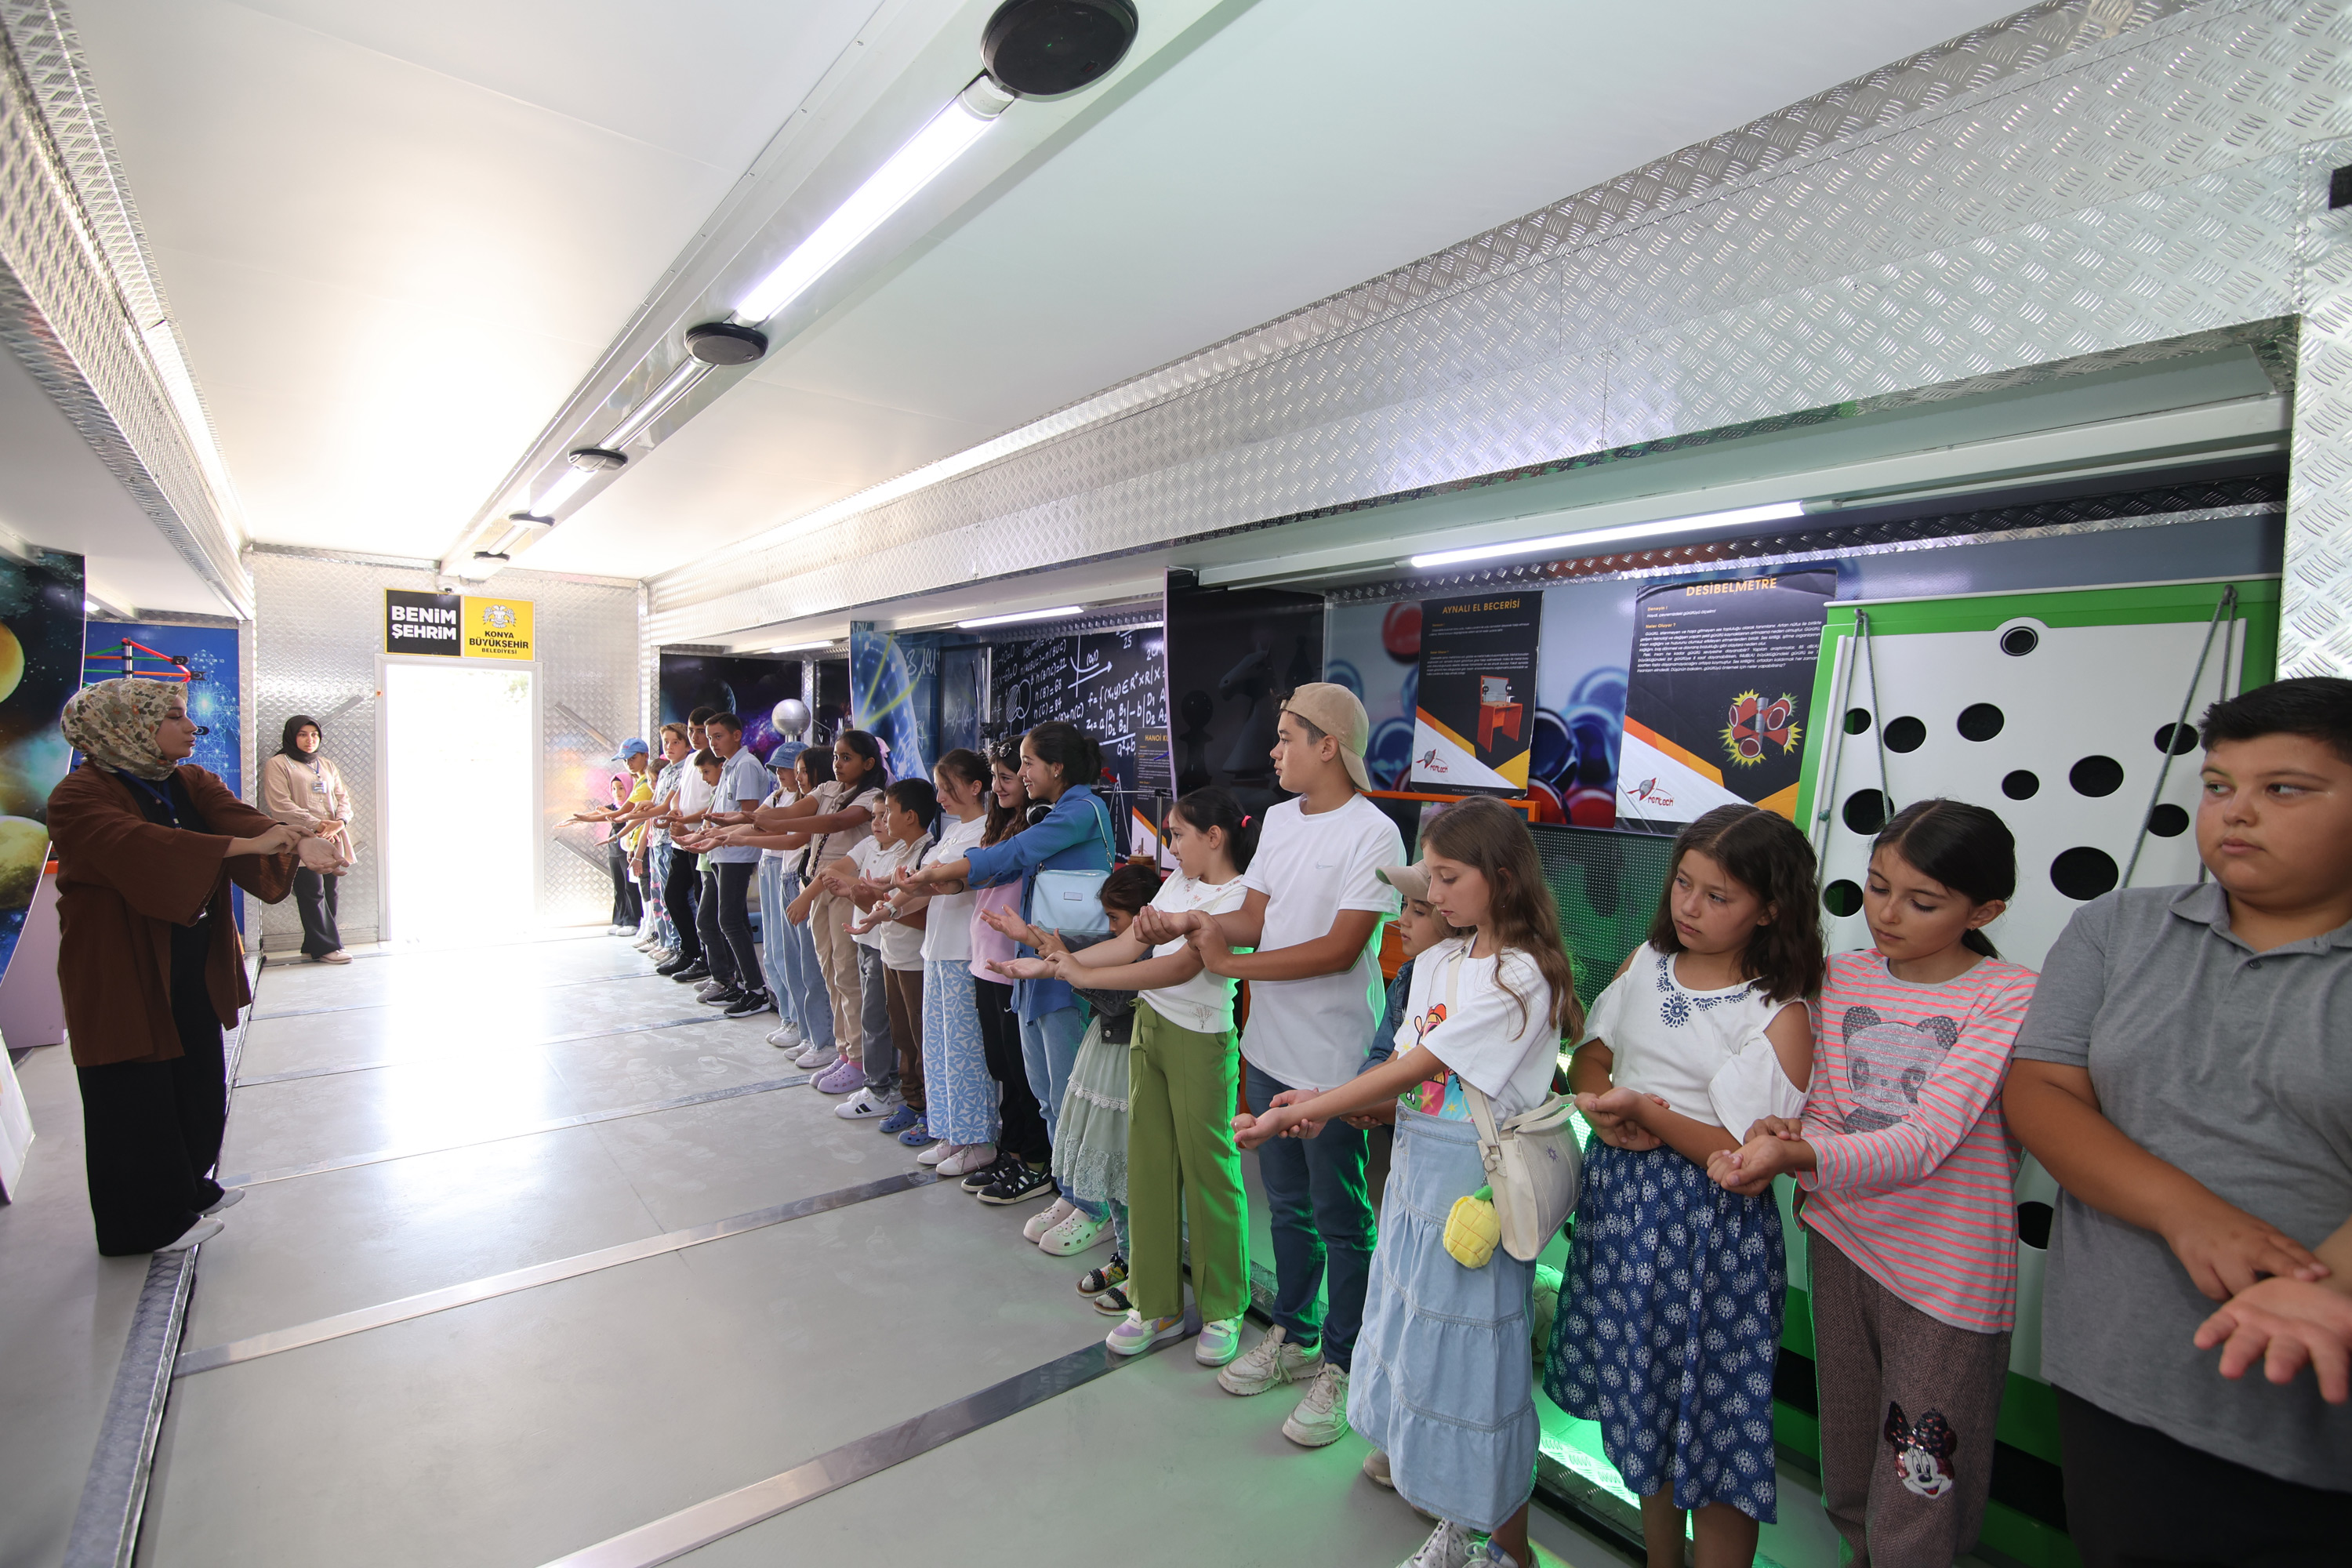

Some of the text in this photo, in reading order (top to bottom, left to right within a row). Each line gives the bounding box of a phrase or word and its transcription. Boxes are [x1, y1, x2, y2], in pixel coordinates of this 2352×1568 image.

[1686, 578, 1777, 596] DESİBELMETRE
[1443, 604, 1471, 614] AYNALI
[1483, 598, 1520, 611] BECERİSİ
[391, 605, 456, 625] BENİM
[391, 623, 456, 641] ŞEHRİM
[485, 630, 514, 639] KONYA
[469, 637, 529, 649] BÜYÜKŞEHİR
[1648, 797, 1674, 806] rentech
